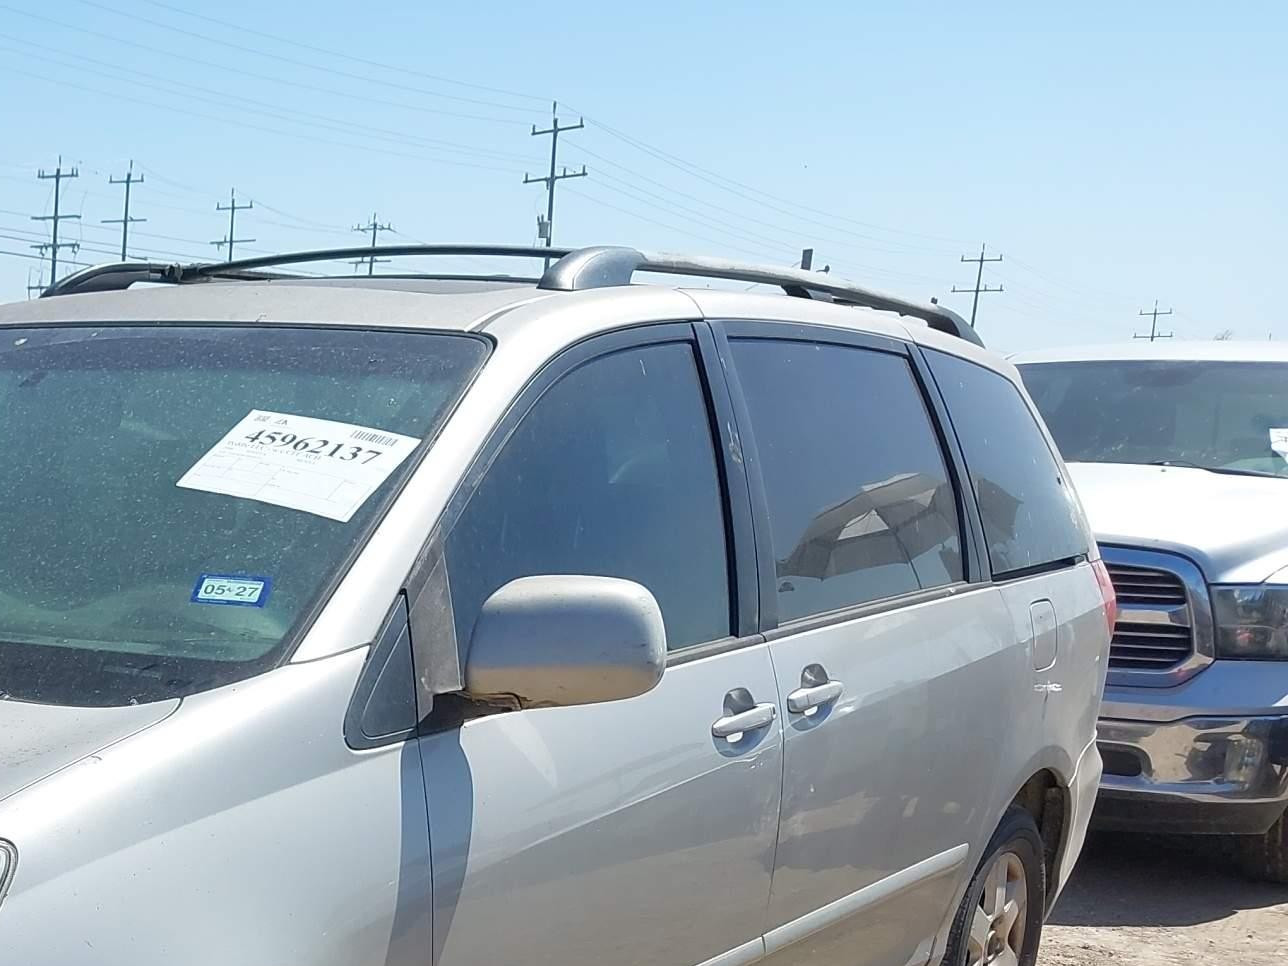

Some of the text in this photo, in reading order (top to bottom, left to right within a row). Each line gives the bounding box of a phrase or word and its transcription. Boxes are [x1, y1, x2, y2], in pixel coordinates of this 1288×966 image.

[244, 428, 383, 466] 45962137
[203, 584, 260, 598] 05 27
